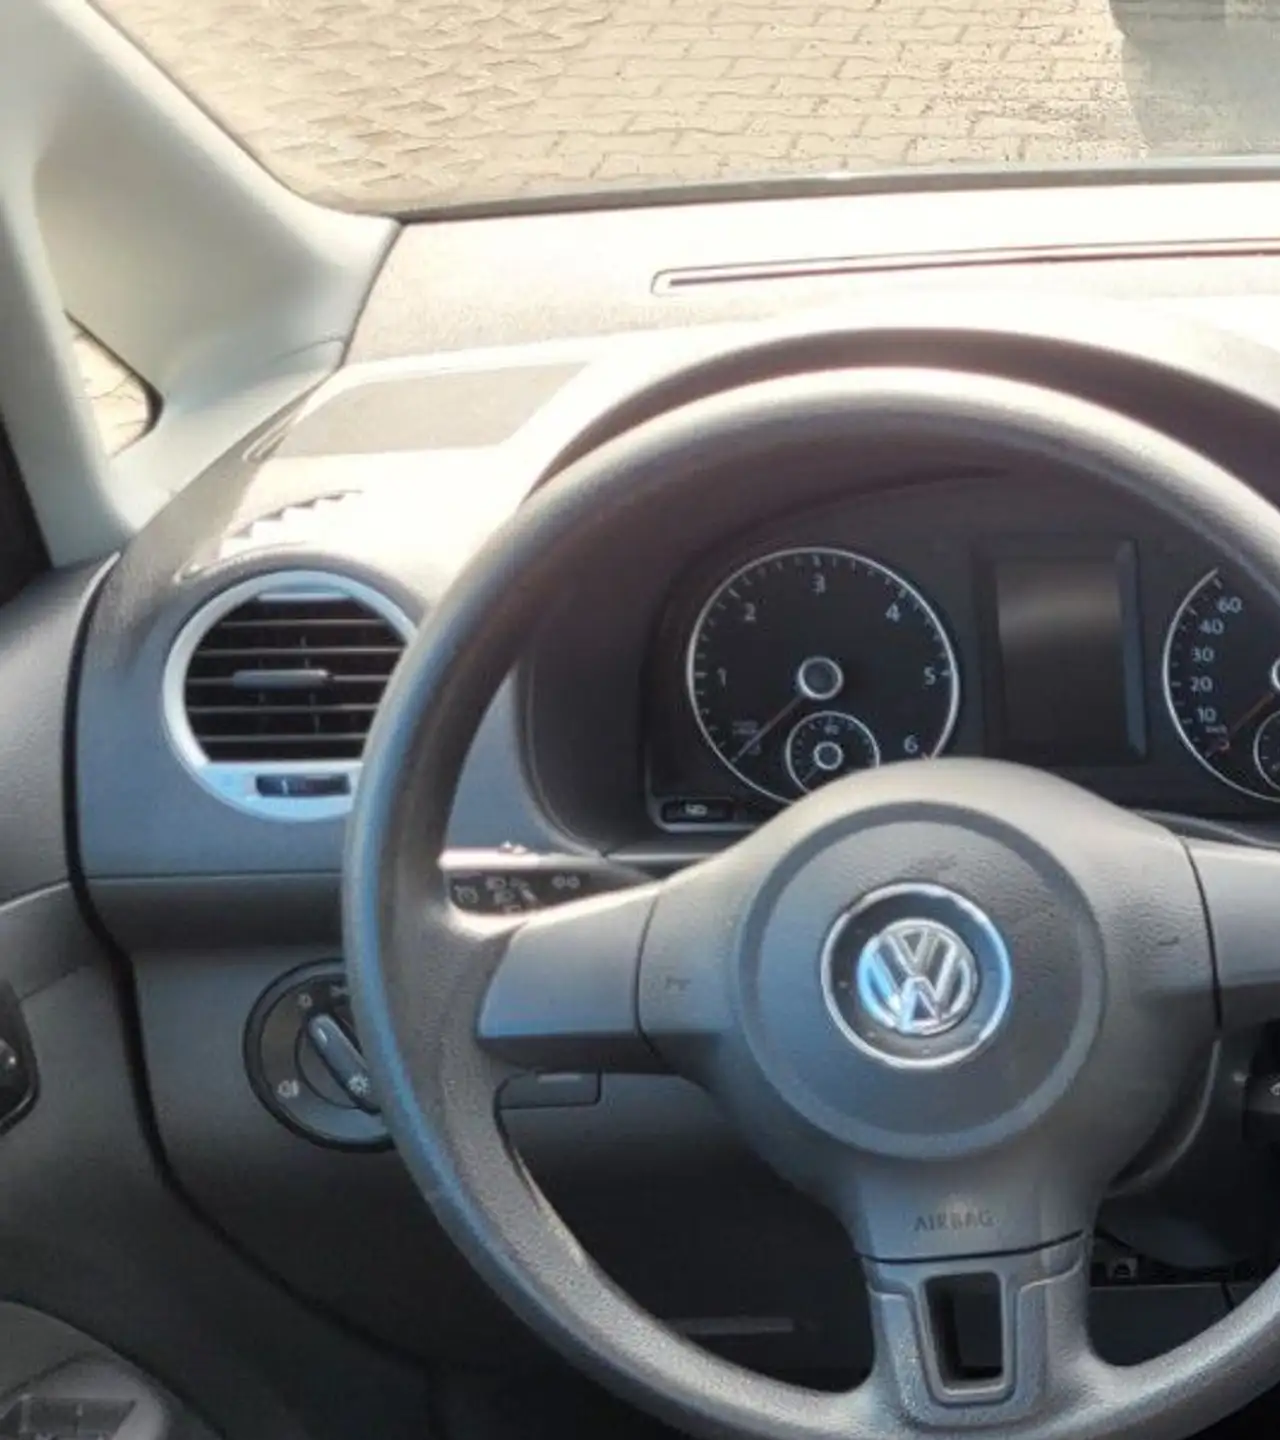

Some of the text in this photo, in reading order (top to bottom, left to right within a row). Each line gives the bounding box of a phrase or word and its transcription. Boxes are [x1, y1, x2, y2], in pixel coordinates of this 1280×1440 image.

[813, 574, 827, 594] 3
[744, 603, 757, 622] 2
[886, 603, 901, 621] 4
[1219, 597, 1241, 613] 60
[1200, 619, 1224, 635] 40
[1192, 648, 1215, 662] 30
[925, 667, 936, 686] 5
[1191, 677, 1213, 692] 20
[1198, 708, 1216, 722] 10
[904, 734, 918, 753] 6
[914, 1209, 996, 1231] AIRBAG
